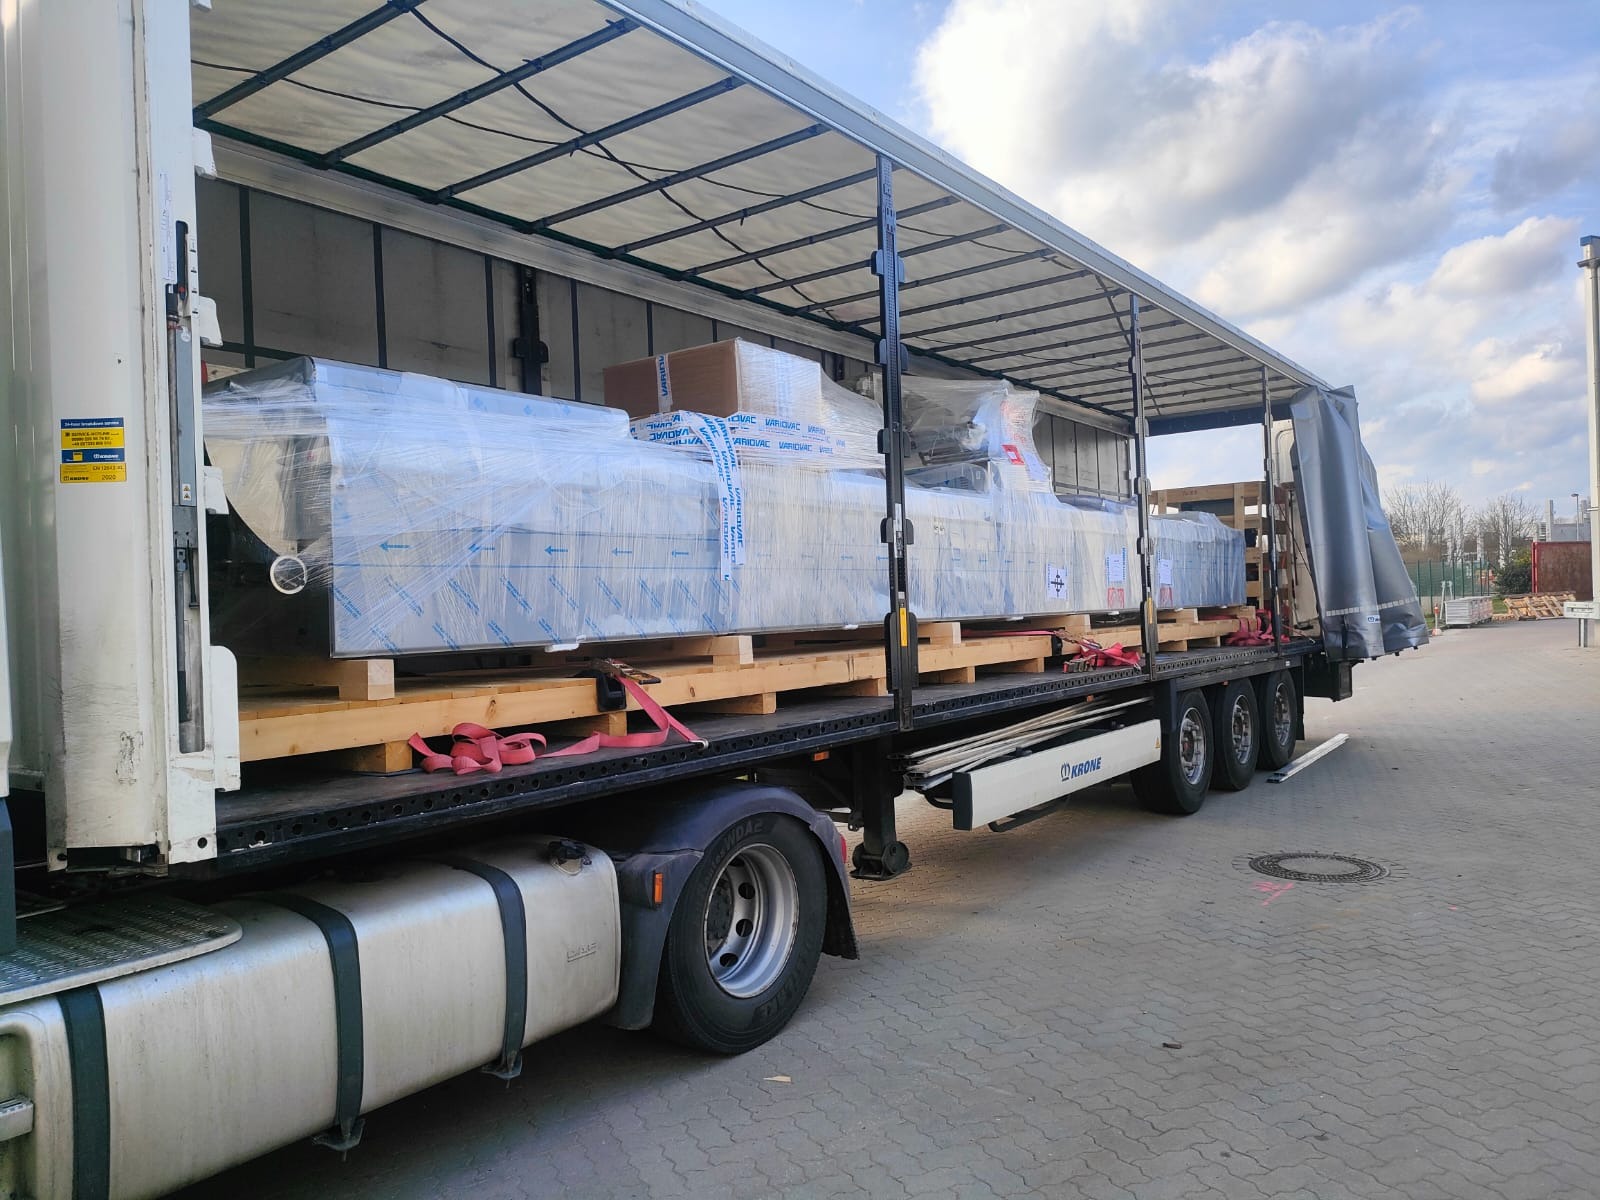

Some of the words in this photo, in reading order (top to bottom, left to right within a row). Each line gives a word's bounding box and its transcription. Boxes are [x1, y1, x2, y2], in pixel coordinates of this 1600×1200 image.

[728, 414, 757, 424] IOVAC
[765, 418, 801, 431] VARIOVAC
[732, 437, 771, 449] ARIOVAC
[779, 441, 814, 452] VARIOVAC
[1071, 756, 1102, 780] KRONE
